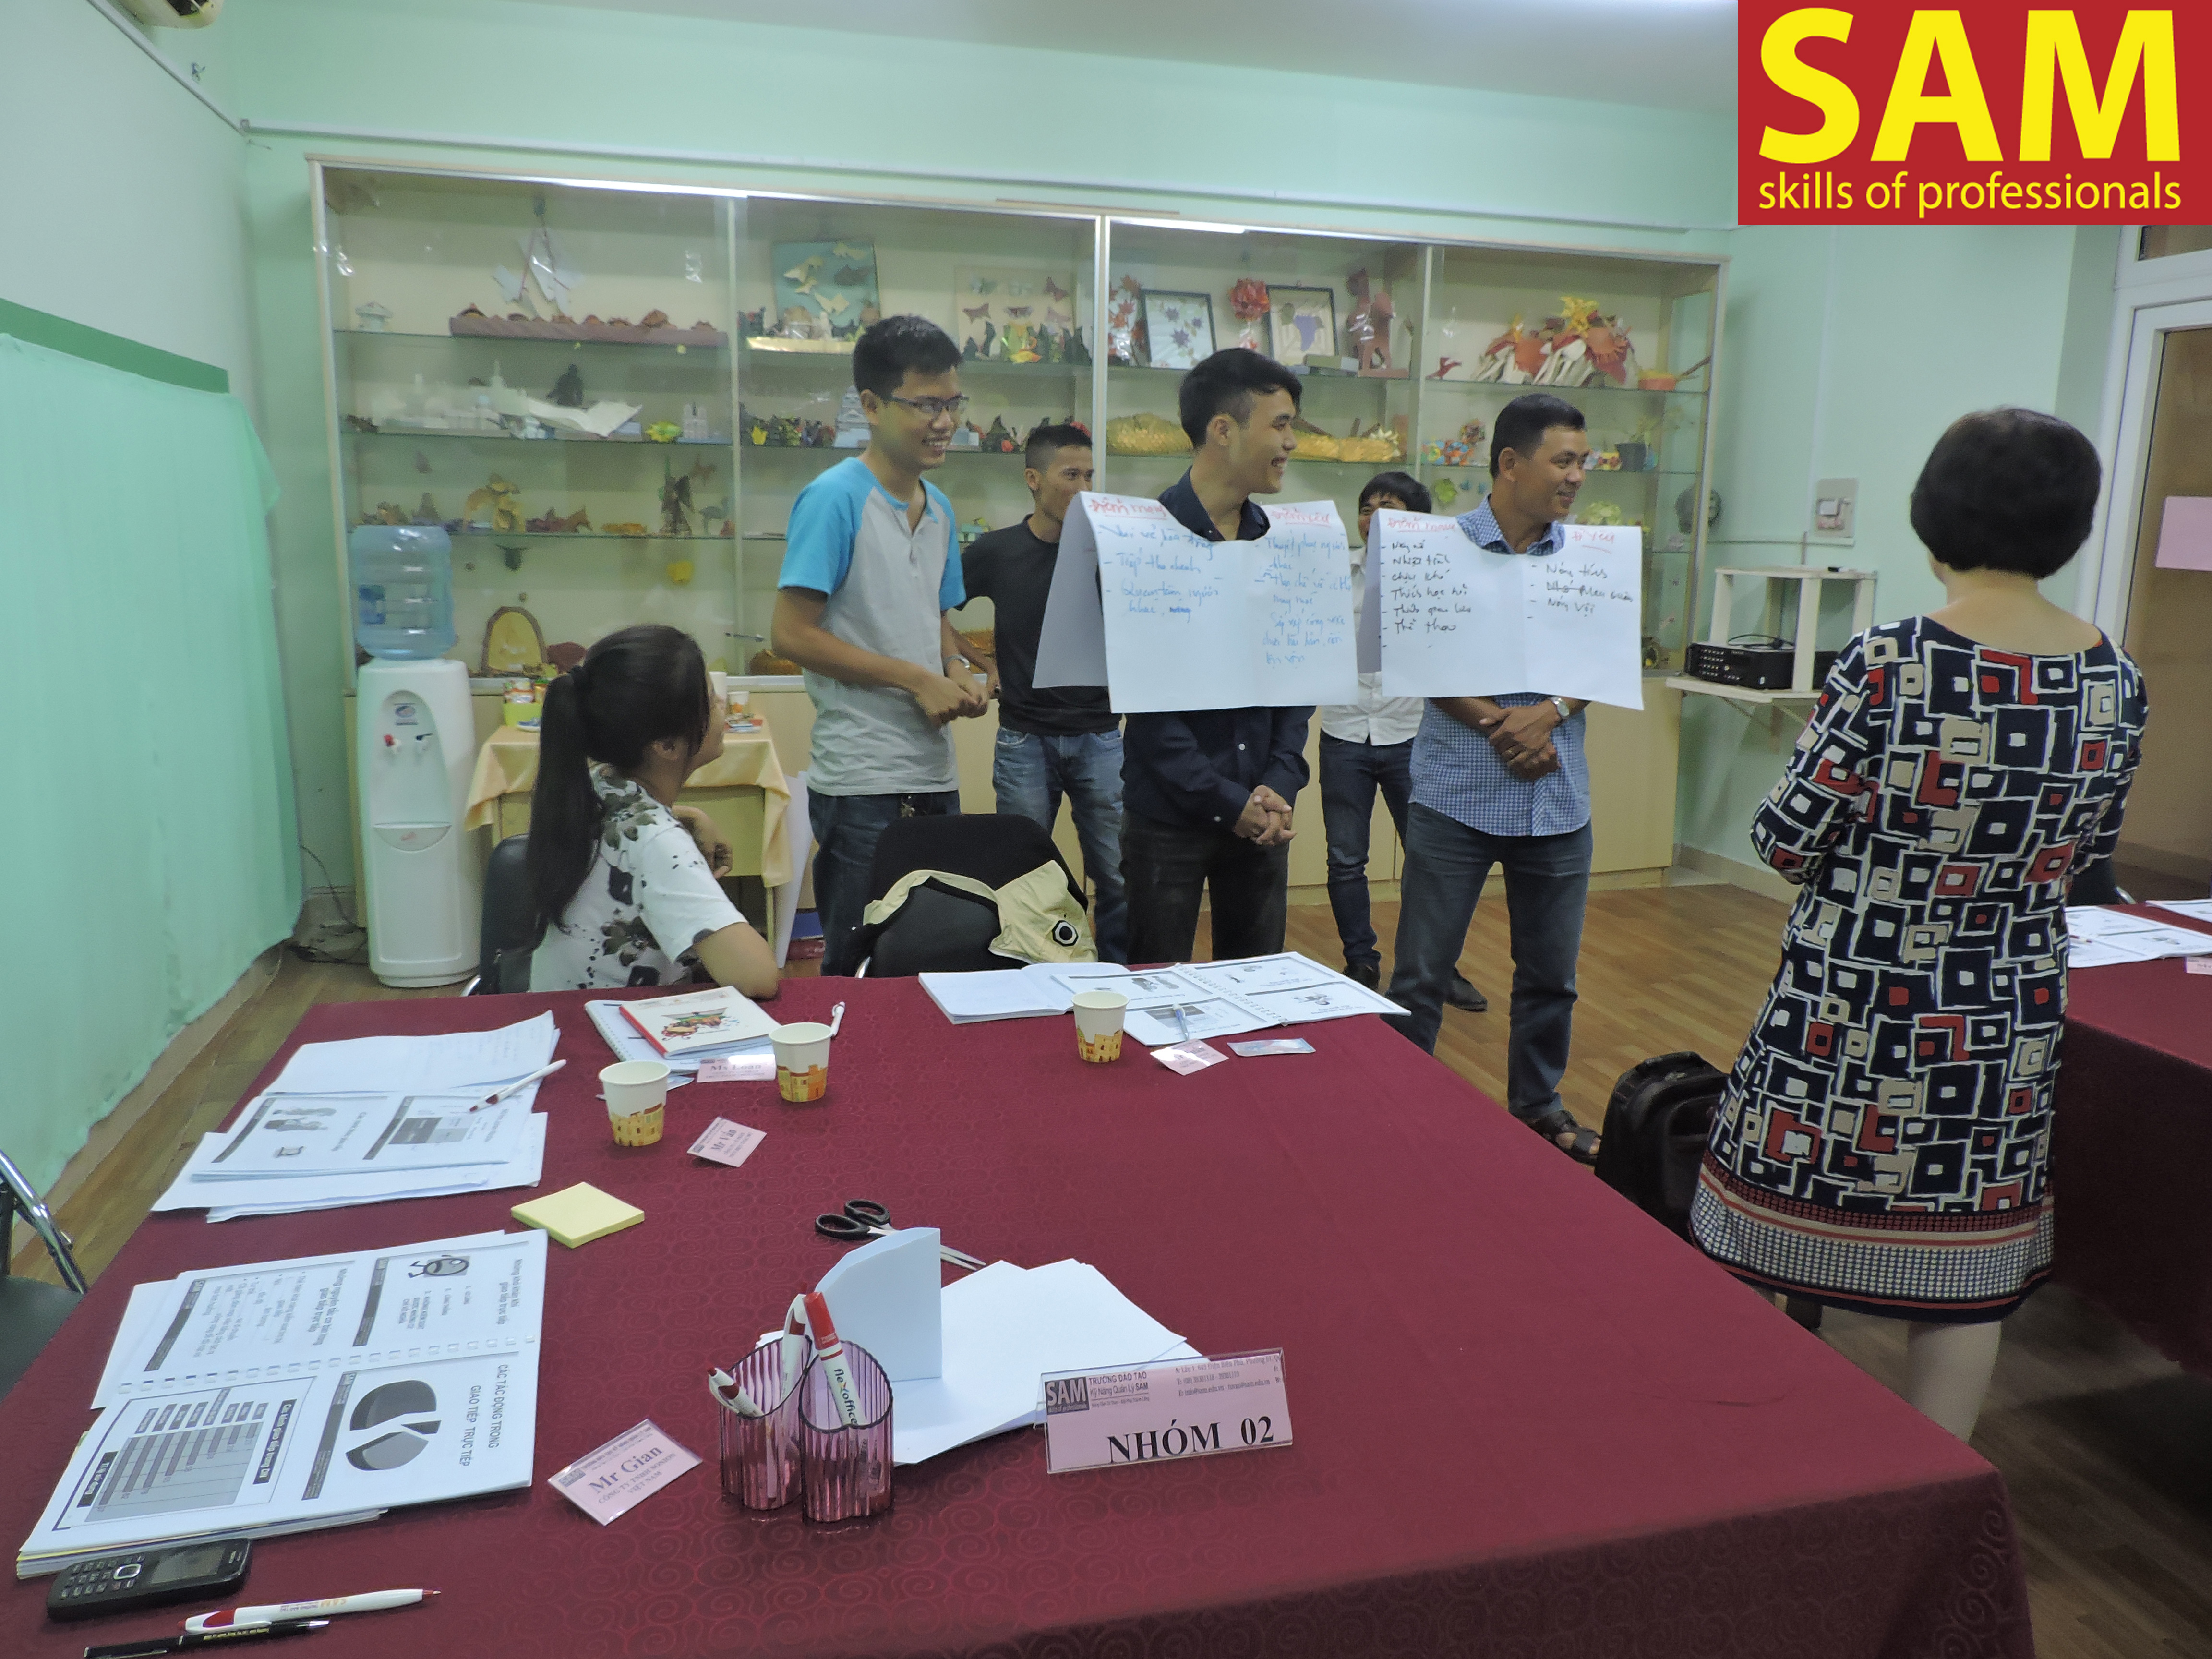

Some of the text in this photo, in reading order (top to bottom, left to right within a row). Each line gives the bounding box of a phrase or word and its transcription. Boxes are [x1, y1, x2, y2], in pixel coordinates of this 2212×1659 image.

[469, 1385, 481, 1405] GIAO
[1046, 1378, 1086, 1406] SAM
[488, 1420, 502, 1449] TRONG
[1107, 1416, 1274, 1464] NHÓM 02
[589, 1472, 619, 1494] Mr
[621, 1447, 662, 1472] Gian
